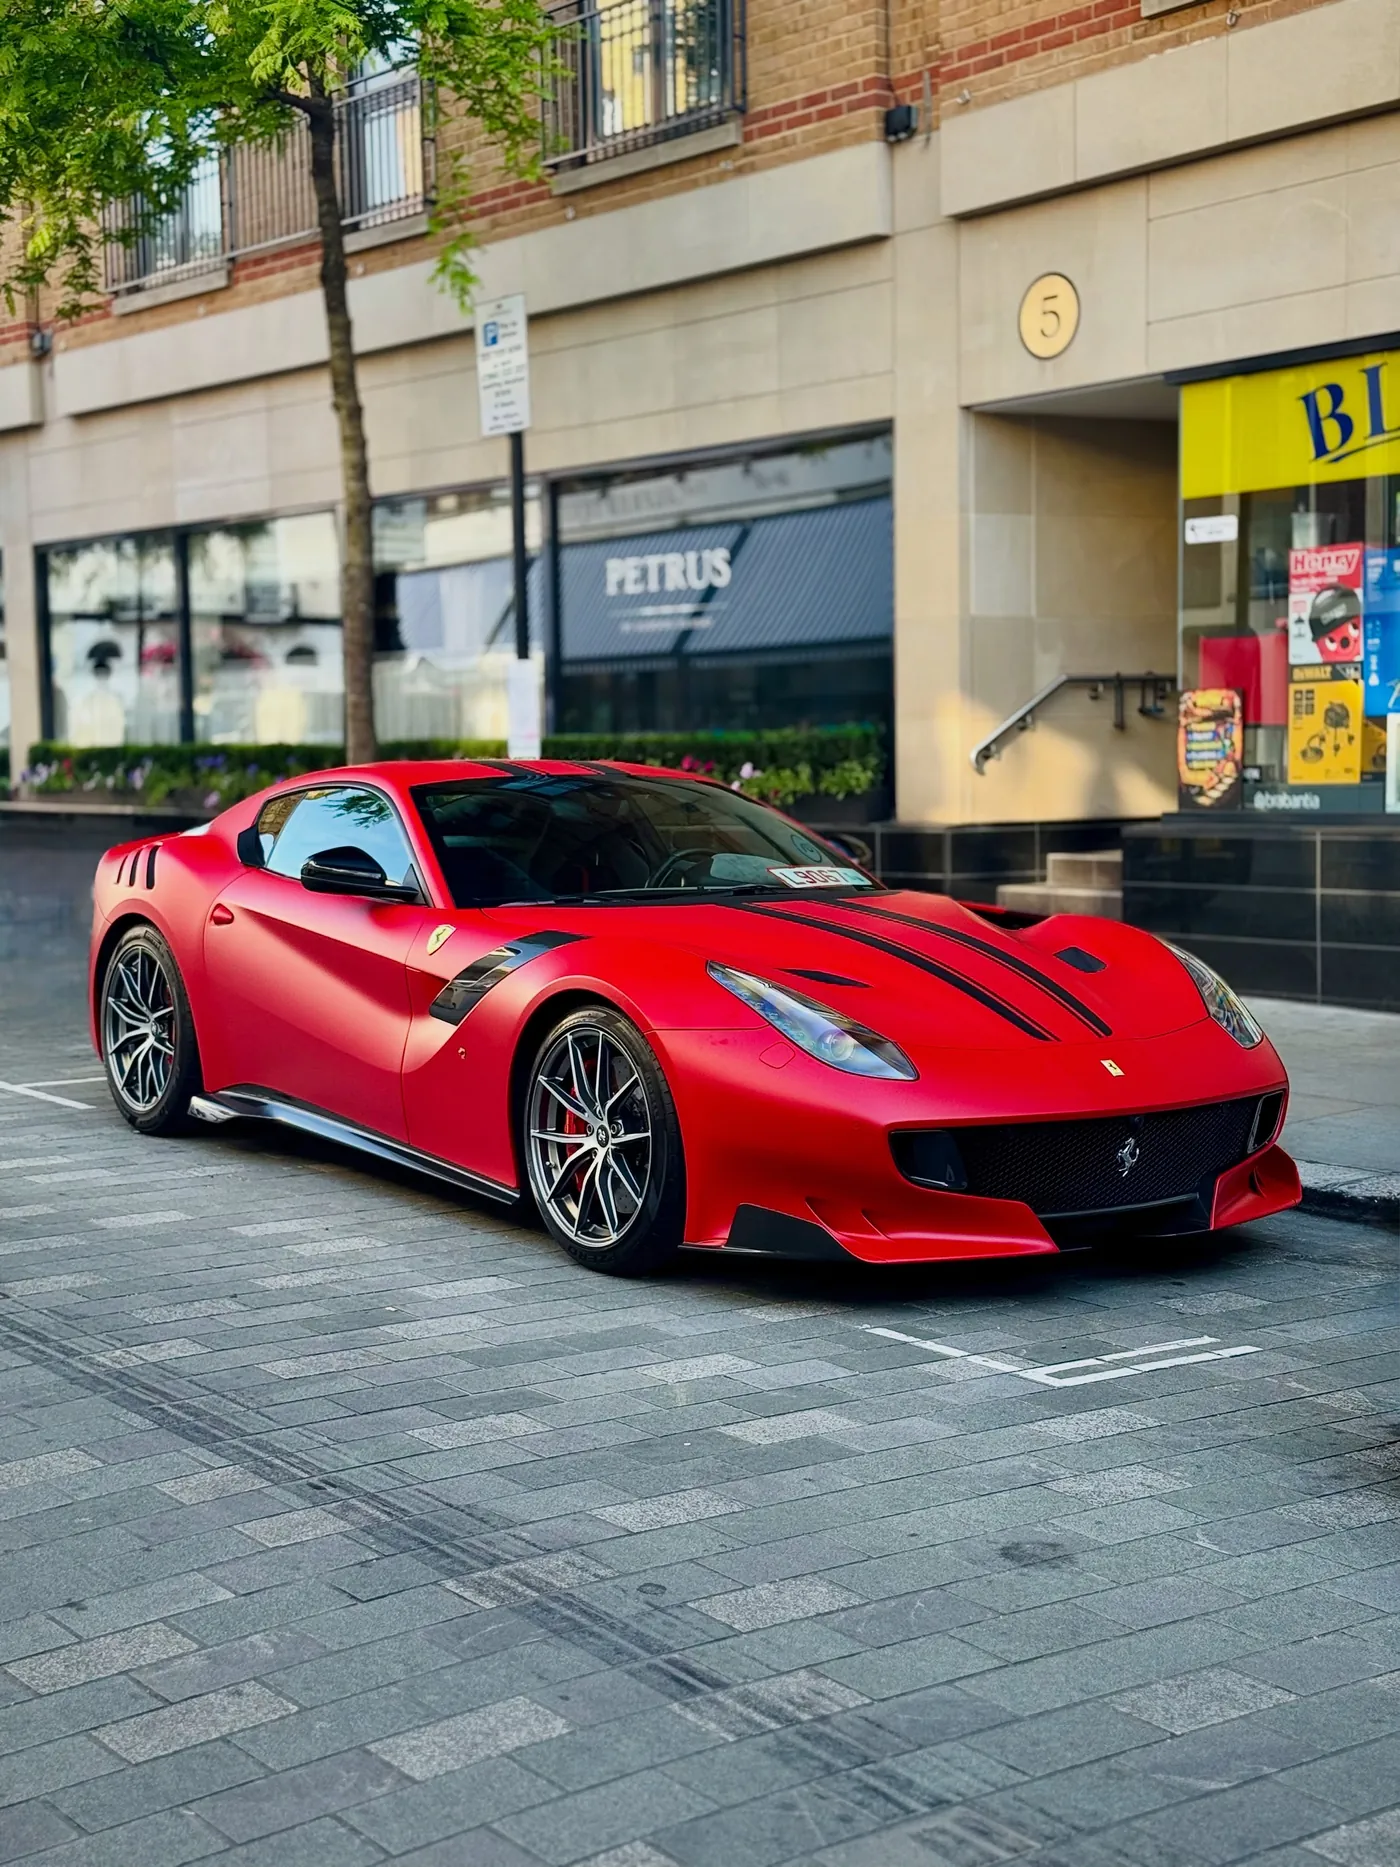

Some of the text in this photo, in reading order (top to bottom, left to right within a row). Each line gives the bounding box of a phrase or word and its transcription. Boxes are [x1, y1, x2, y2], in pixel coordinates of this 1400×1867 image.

[1040, 294, 1061, 338] 5
[605, 546, 732, 596] PETRUS
[1291, 551, 1359, 574] Henry
